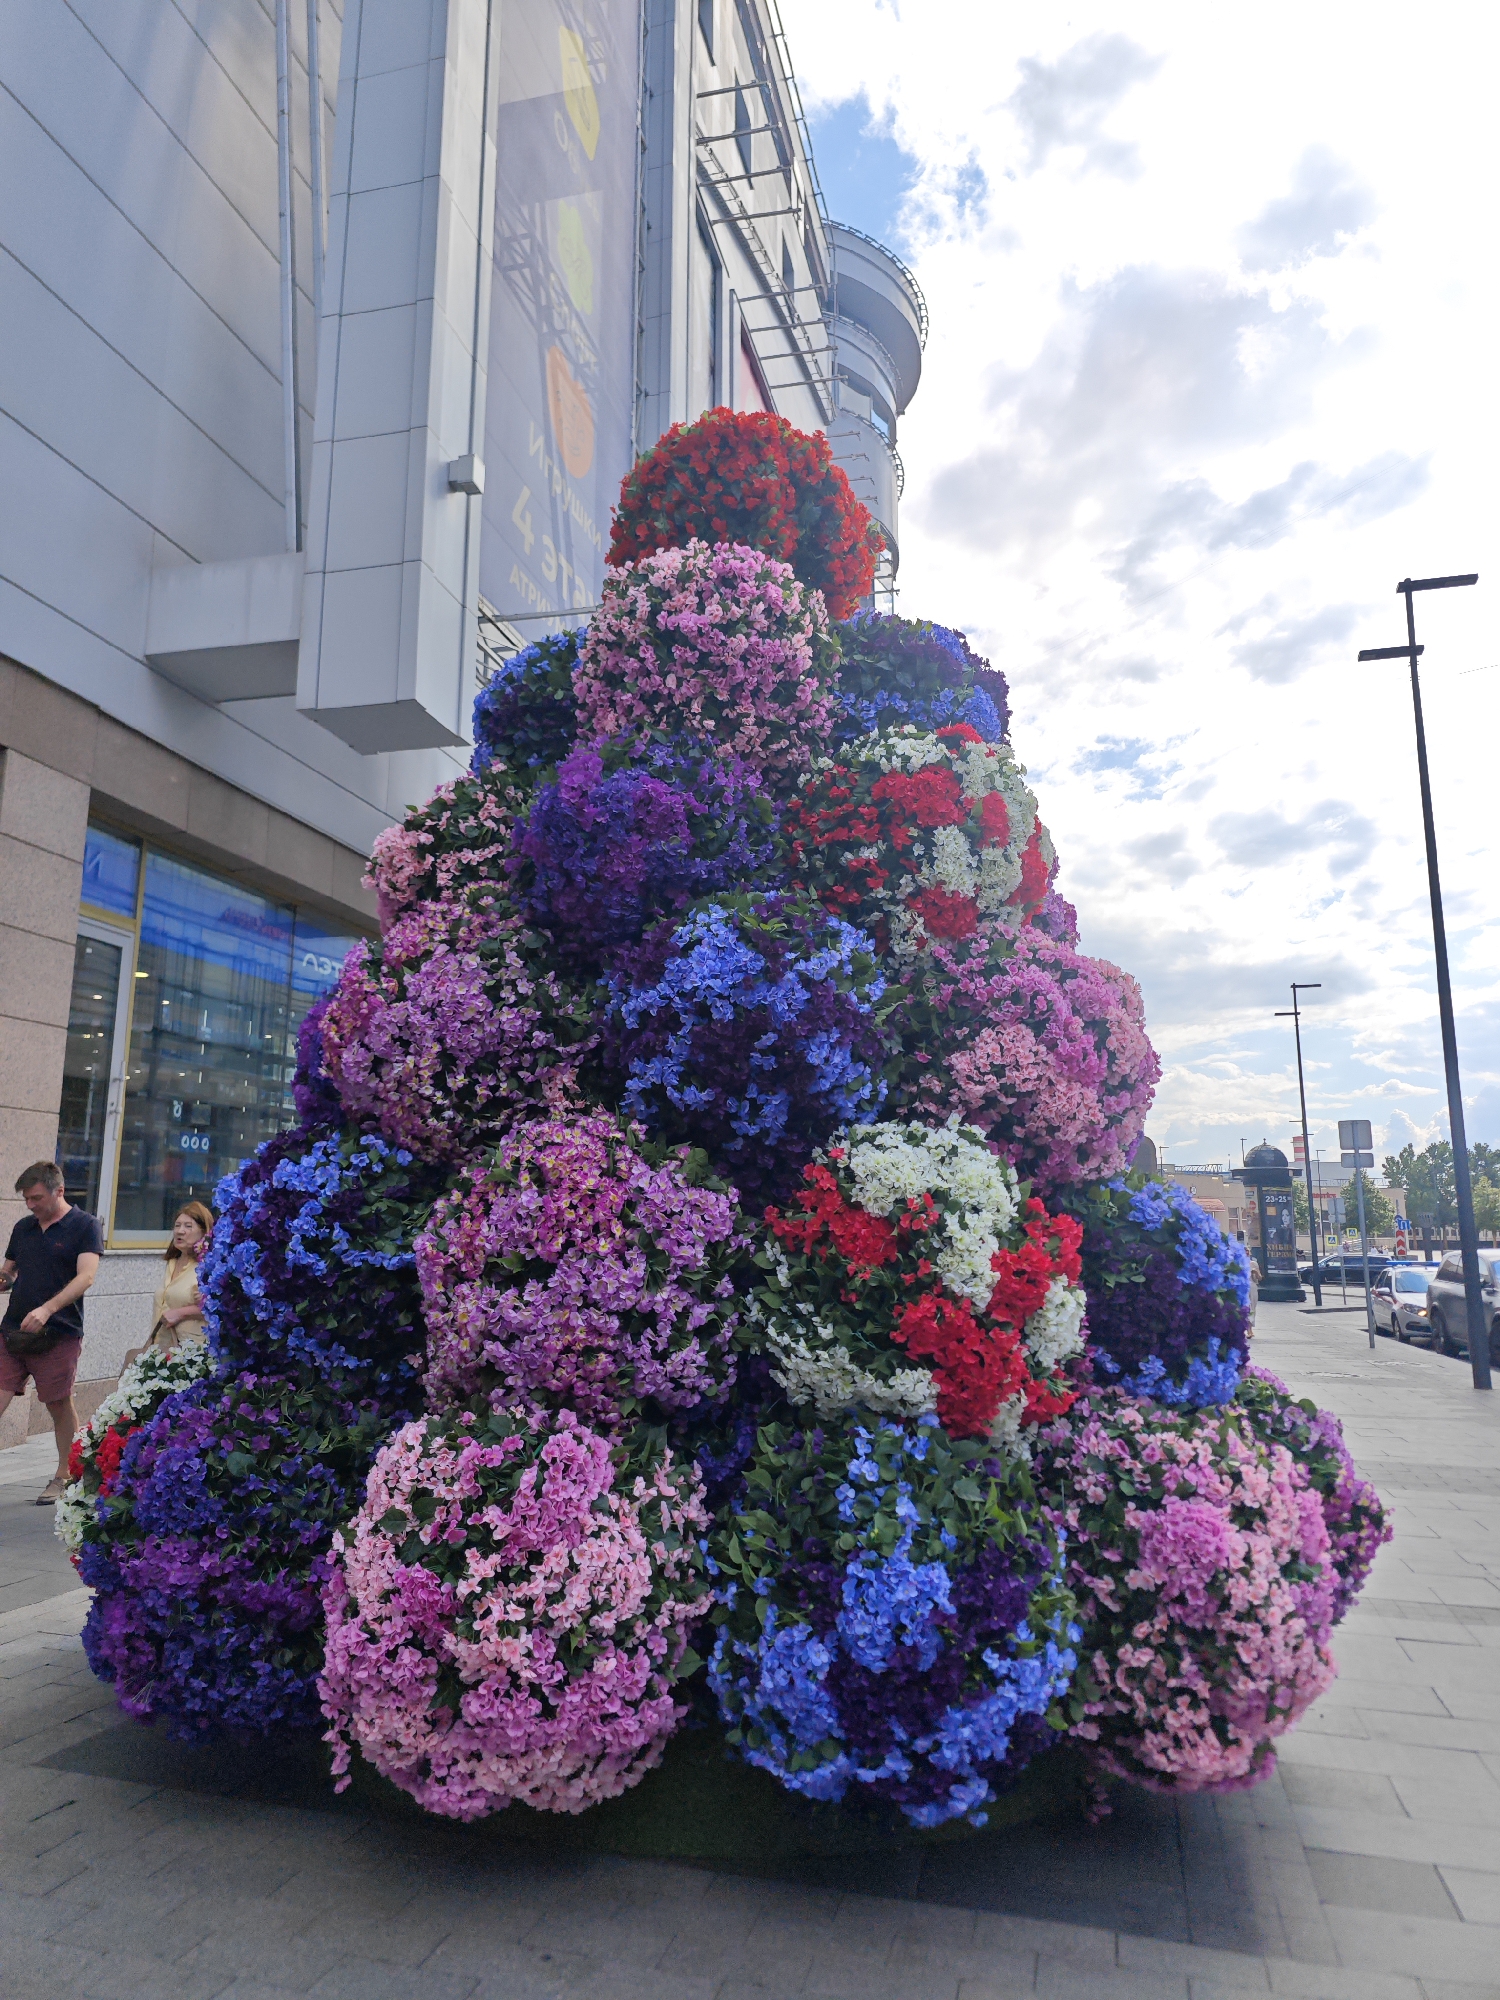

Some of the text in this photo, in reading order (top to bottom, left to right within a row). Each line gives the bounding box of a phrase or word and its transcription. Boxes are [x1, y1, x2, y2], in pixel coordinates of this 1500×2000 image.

[529, 420, 602, 553] Игрушки
[512, 485, 600, 623] 4 эта
[302, 953, 344, 979] ЛЭТ
